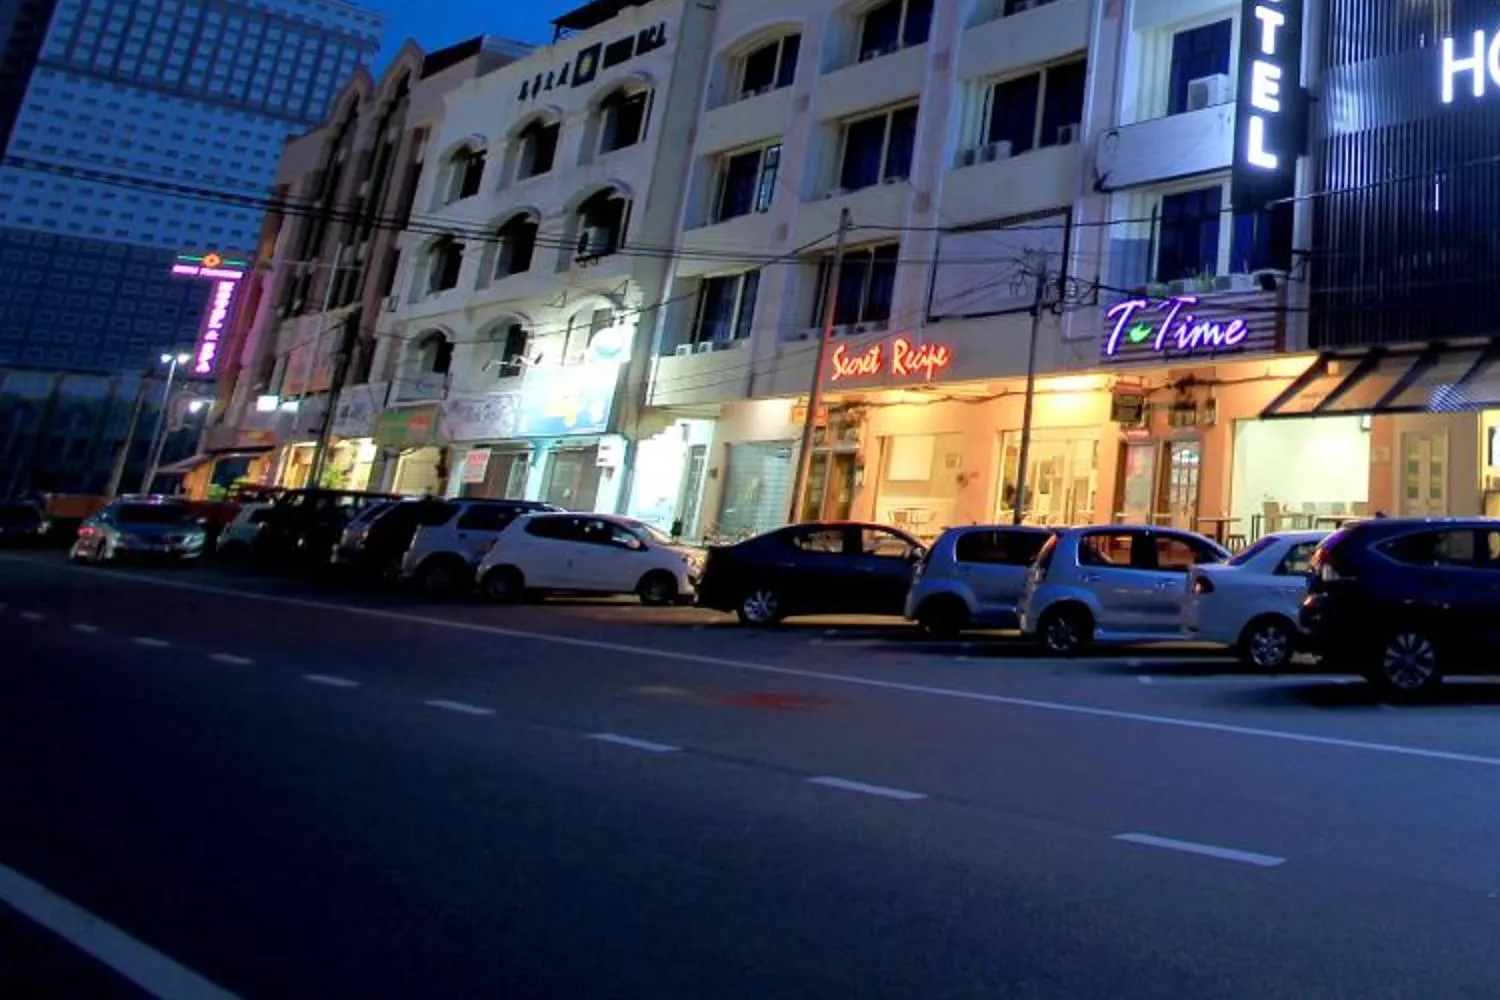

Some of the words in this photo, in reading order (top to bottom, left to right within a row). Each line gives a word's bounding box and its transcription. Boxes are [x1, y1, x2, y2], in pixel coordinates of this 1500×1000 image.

[1155, 296, 1248, 350] Time
[831, 344, 881, 381] Secret
[892, 338, 950, 382] Recipe
